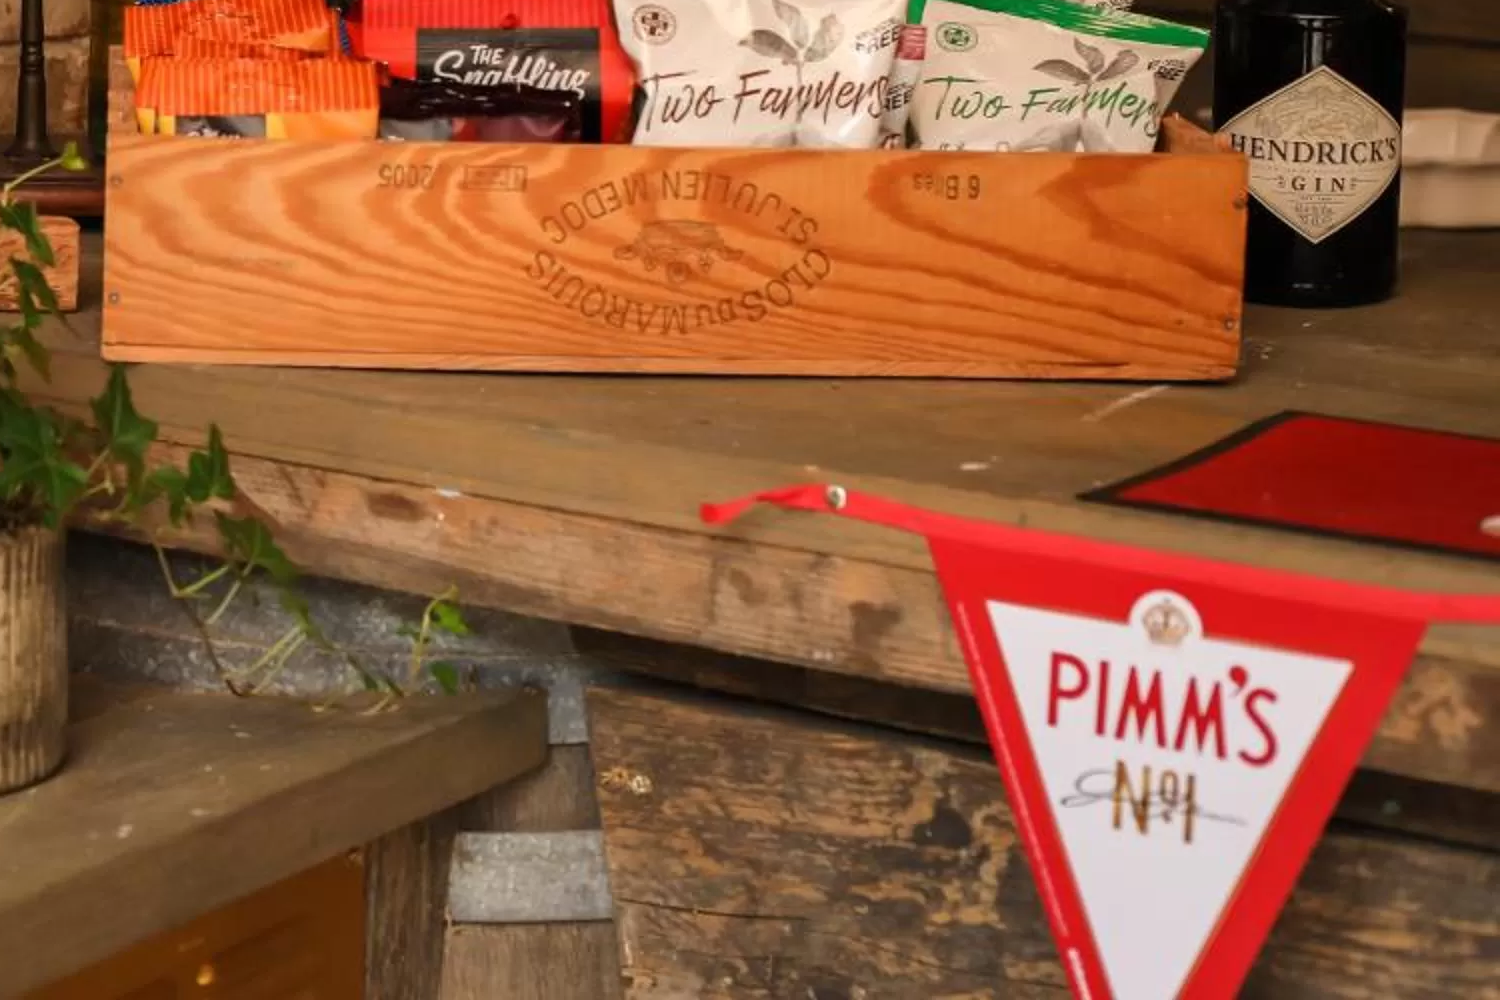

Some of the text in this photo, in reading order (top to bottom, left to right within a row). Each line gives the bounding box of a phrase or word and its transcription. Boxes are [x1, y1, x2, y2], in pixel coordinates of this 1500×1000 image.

[468, 44, 506, 66] THE
[641, 71, 722, 131] Two
[923, 75, 1013, 121] Two
[1230, 132, 1398, 165] HENDRICK'S
[377, 163, 434, 190] 2005
[661, 169, 781, 218] JULIEN
[967, 175, 981, 201] 6
[1291, 176, 1347, 193] GIN
[539, 172, 650, 245] MEDOC
[523, 249, 690, 337] MARQUIS
[738, 247, 832, 323] CLOS
[1046, 650, 1279, 767] PIMM'S
